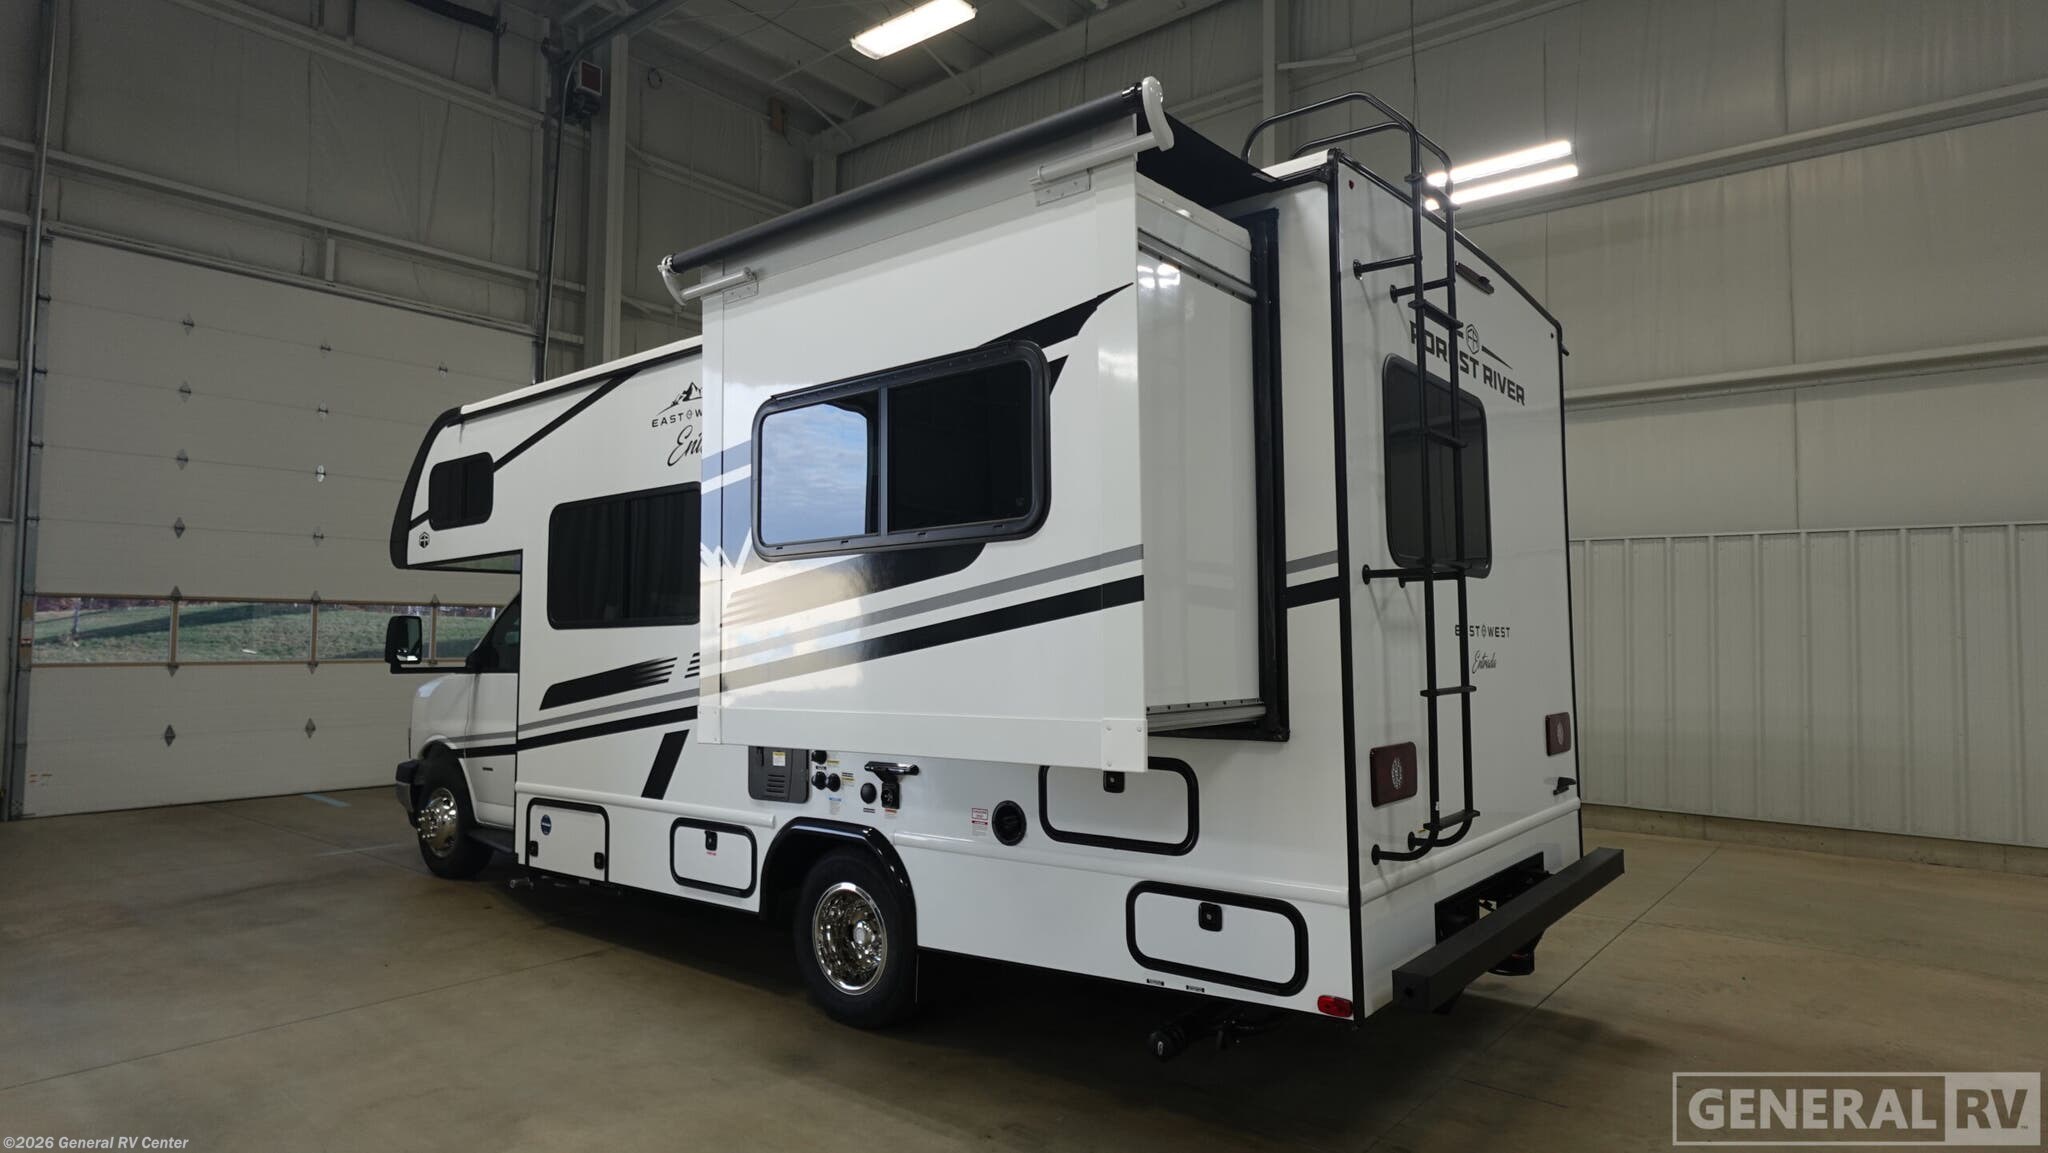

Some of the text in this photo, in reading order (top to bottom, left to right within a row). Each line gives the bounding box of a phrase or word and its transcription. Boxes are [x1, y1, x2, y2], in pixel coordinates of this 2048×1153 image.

[1409, 320, 1525, 406] FORST RIVER
[651, 412, 684, 428] EAST
[1454, 624, 1511, 638] EST WEST
